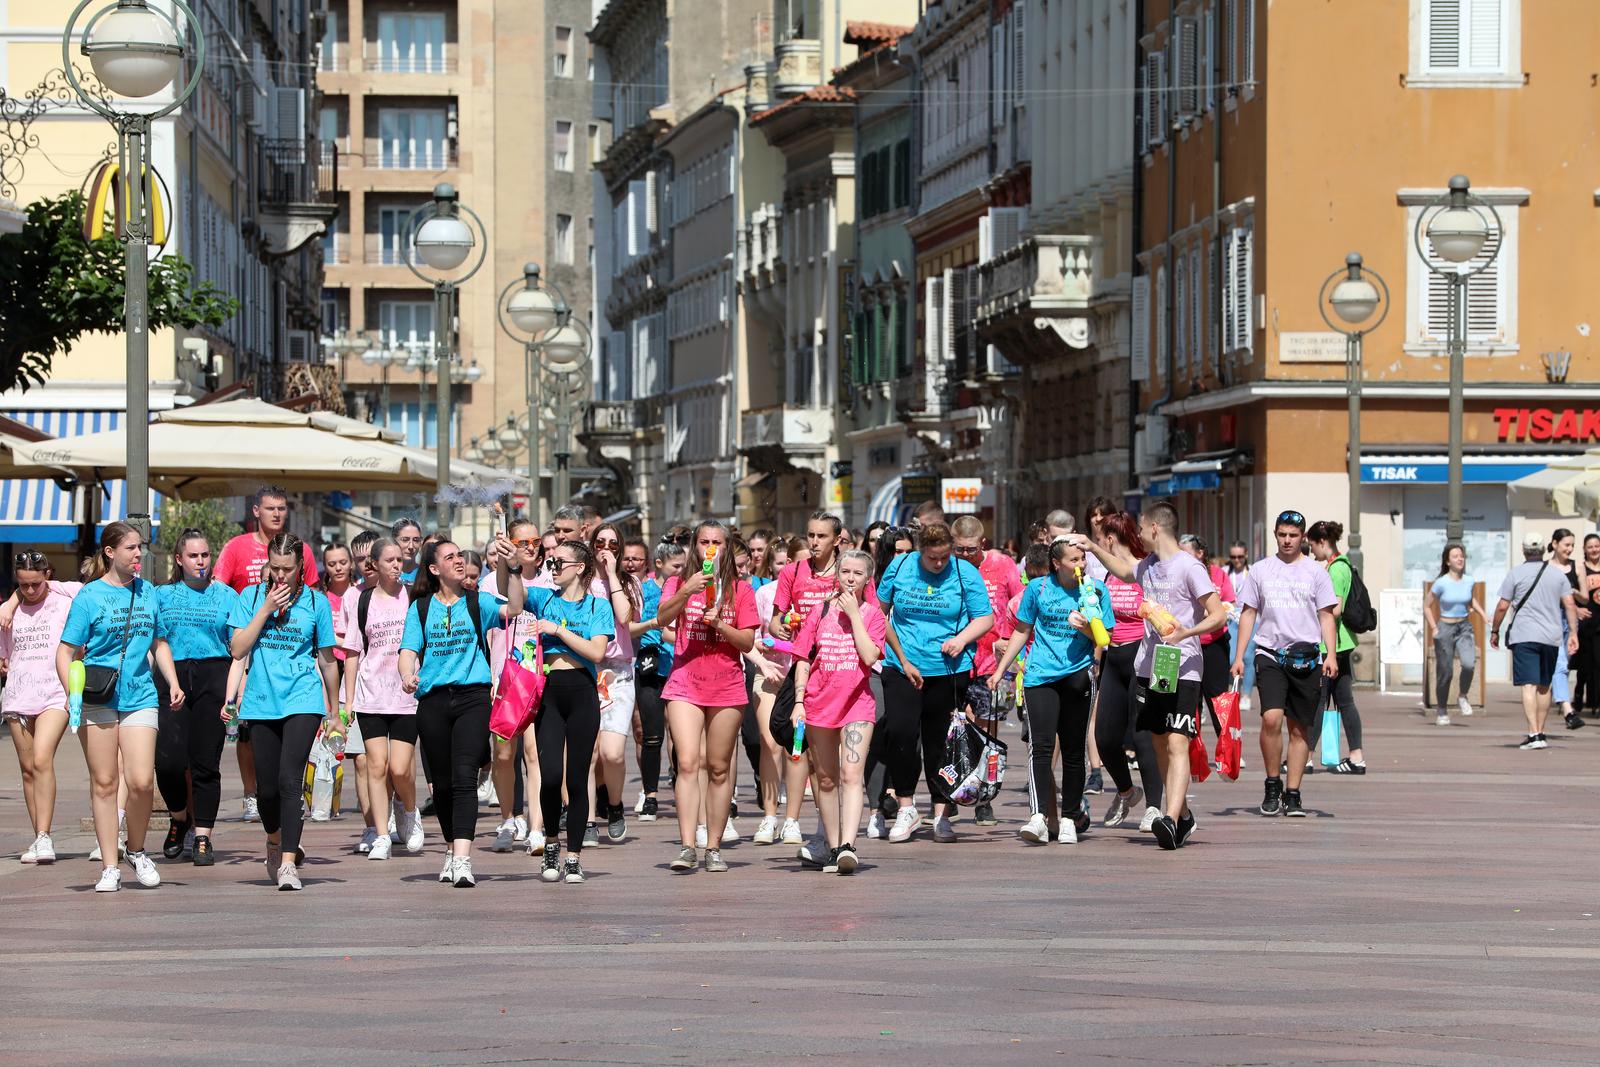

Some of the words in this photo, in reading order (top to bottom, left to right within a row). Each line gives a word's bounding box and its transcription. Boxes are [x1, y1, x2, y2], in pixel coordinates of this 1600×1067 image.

[1494, 408, 1600, 440] TISAK
[1371, 466, 1418, 480] TISAK
[382, 619, 405, 628] SRAMO
[695, 631, 707, 641] YOU
[944, 765, 957, 778] dm
